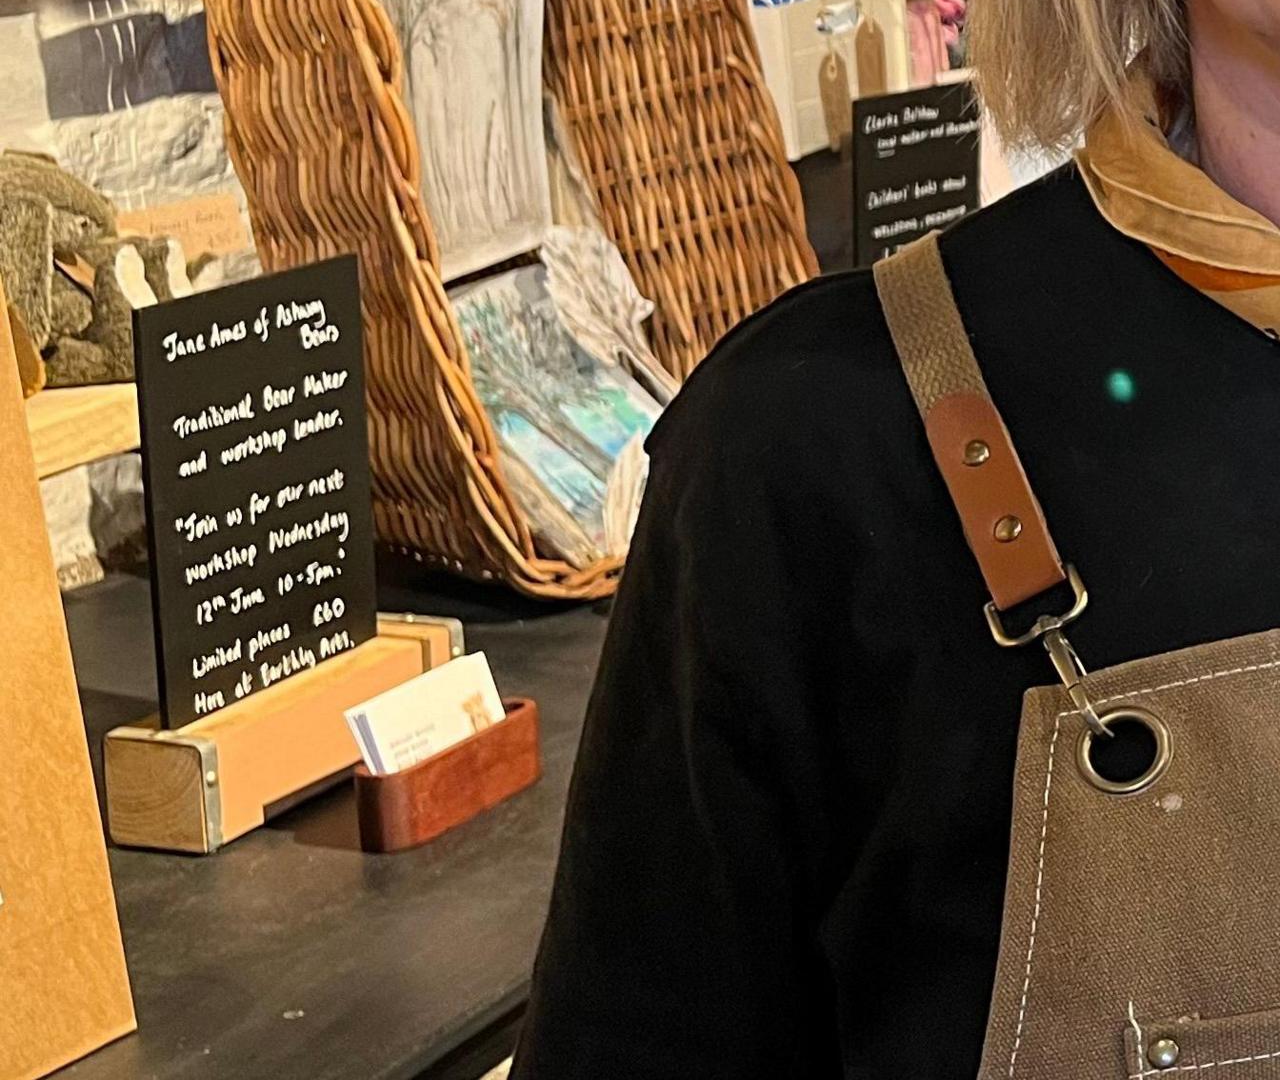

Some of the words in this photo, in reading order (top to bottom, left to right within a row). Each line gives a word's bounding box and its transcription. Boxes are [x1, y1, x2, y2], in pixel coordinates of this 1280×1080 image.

[929, 124, 944, 138] and
[914, 180, 937, 199] books
[163, 332, 206, 362] Jane
[210, 321, 246, 348] Ames
[254, 307, 269, 342] of
[300, 322, 339, 349] Bears
[173, 393, 255, 439] Traditional
[263, 385, 295, 412] Bear
[304, 371, 347, 398] Maker
[179, 451, 207, 477] and
[221, 429, 286, 465] workshop
[226, 508, 242, 526] us
[249, 493, 270, 525] for
[276, 484, 304, 508] our
[308, 469, 343, 496] next
[269, 512, 349, 556] Wednesday
[230, 587, 265, 614] June
[193, 638, 242, 679] Limited
[249, 624, 291, 661] places
[313, 598, 344, 627] £60
[235, 671, 252, 699] at
[260, 647, 316, 686] Earthly
